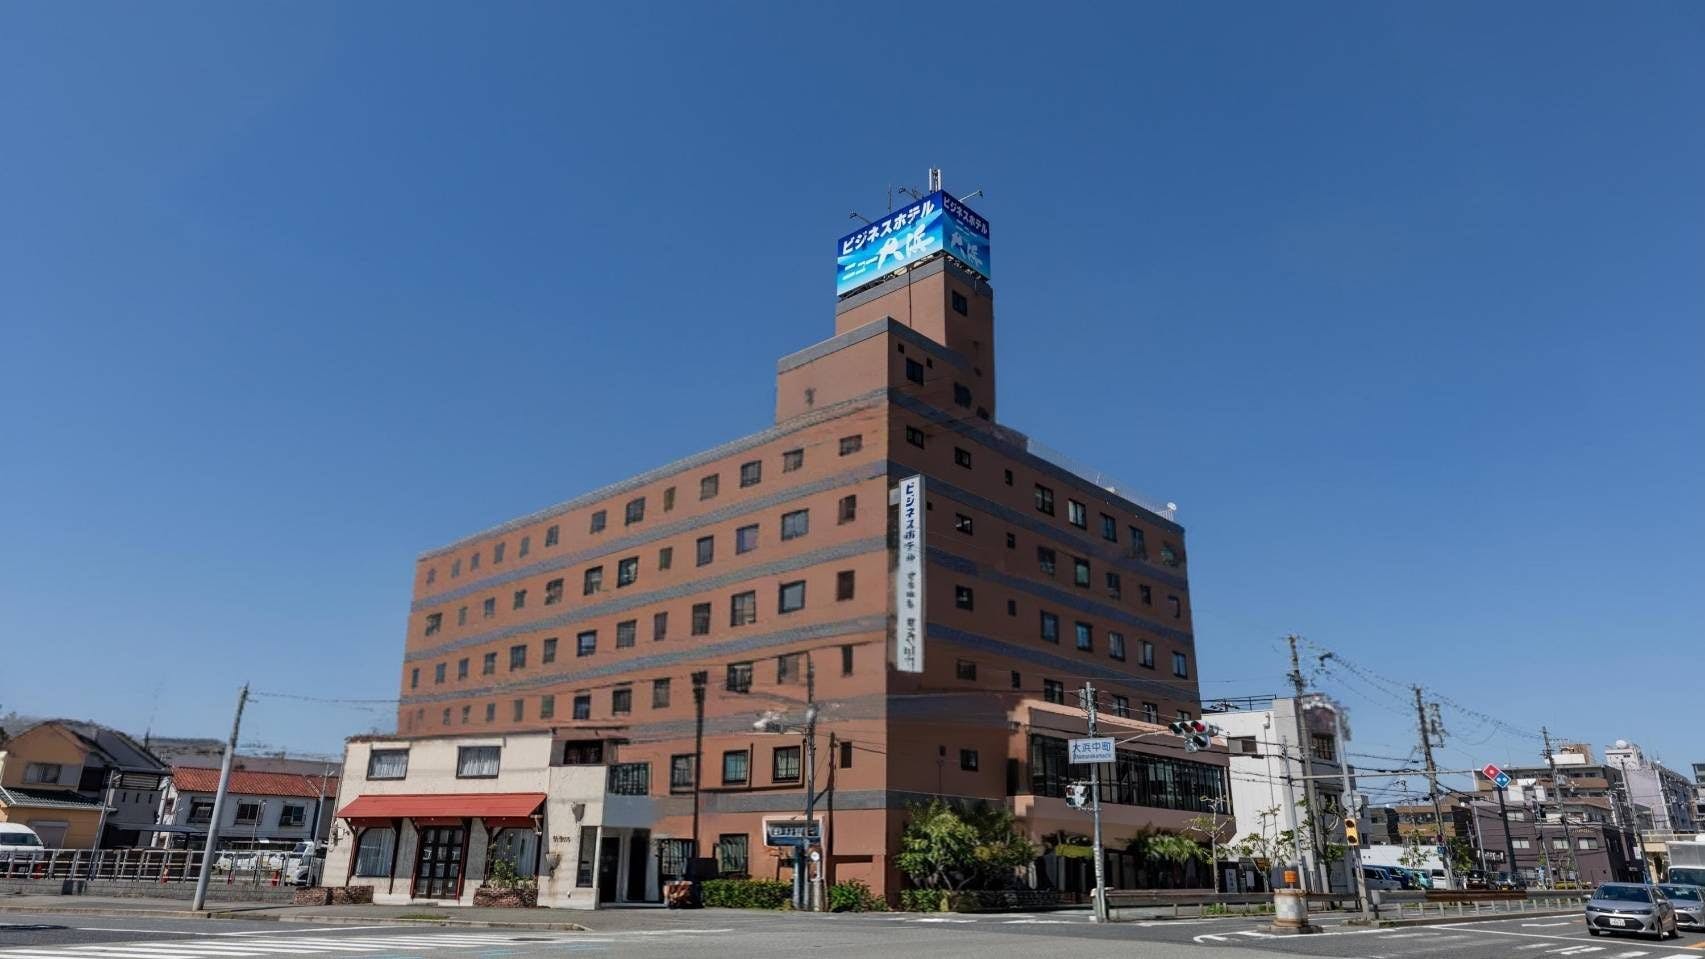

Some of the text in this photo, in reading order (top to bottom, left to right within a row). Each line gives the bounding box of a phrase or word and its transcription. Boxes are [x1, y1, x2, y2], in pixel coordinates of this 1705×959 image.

[842, 199, 935, 255] ビジネスホテル
[943, 196, 988, 235] ビジネスホテル
[1072, 741, 1111, 753] 大浜中町
